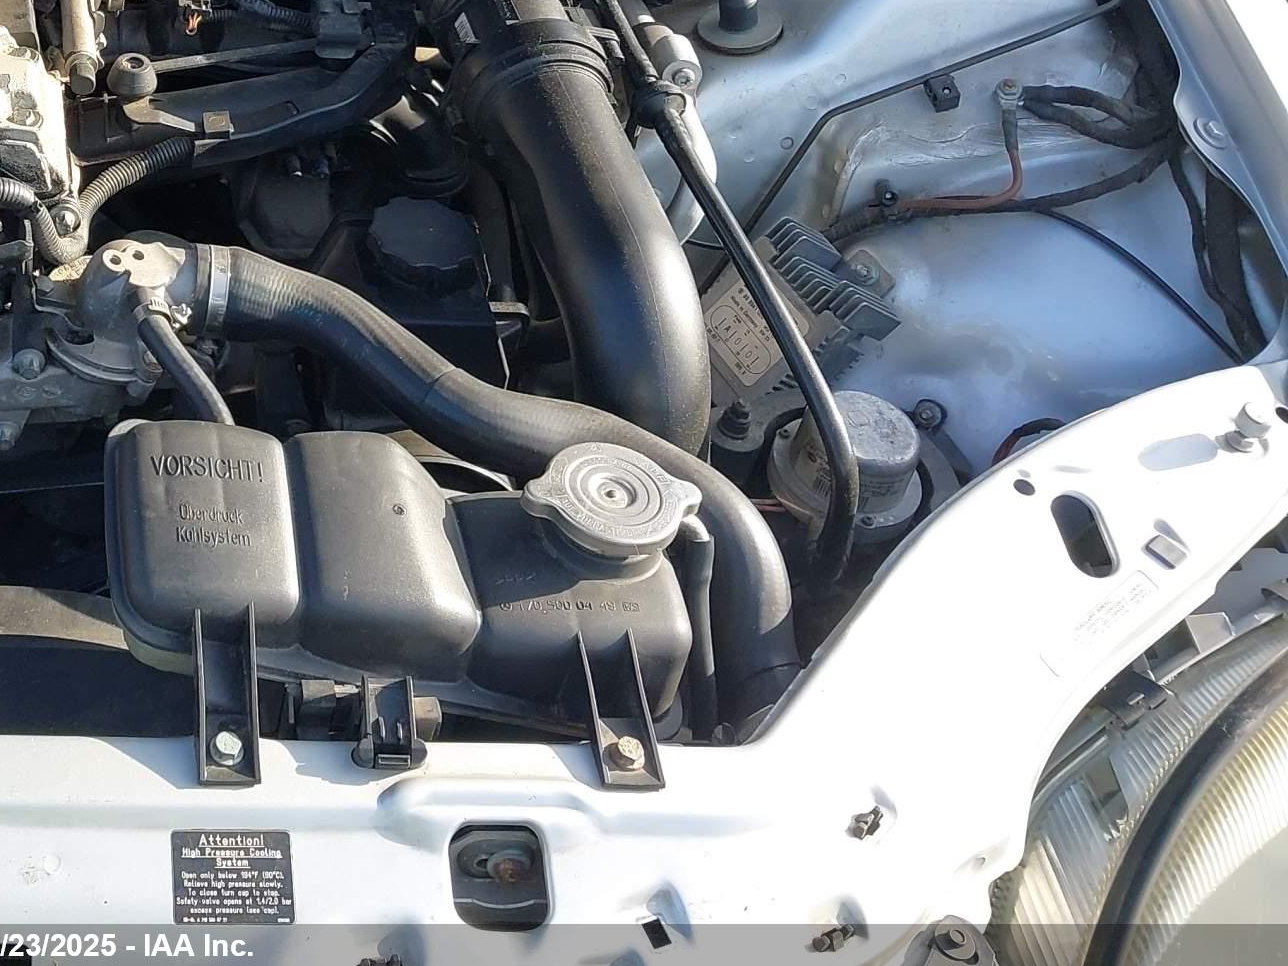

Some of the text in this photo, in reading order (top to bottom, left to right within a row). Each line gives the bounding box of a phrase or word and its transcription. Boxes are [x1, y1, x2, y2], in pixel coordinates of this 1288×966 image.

[150, 454, 264, 482] VORSICHT!
[199, 834, 264, 846] Attention!
[182, 848, 281, 858] High Pressure Cooling
[215, 859, 249, 868] System
[183, 880, 208, 888] Relieve
[211, 880, 225, 889] high
[228, 881, 255, 889] pressure
[176, 897, 198, 906] Safety
[215, 907, 243, 915] pressure
